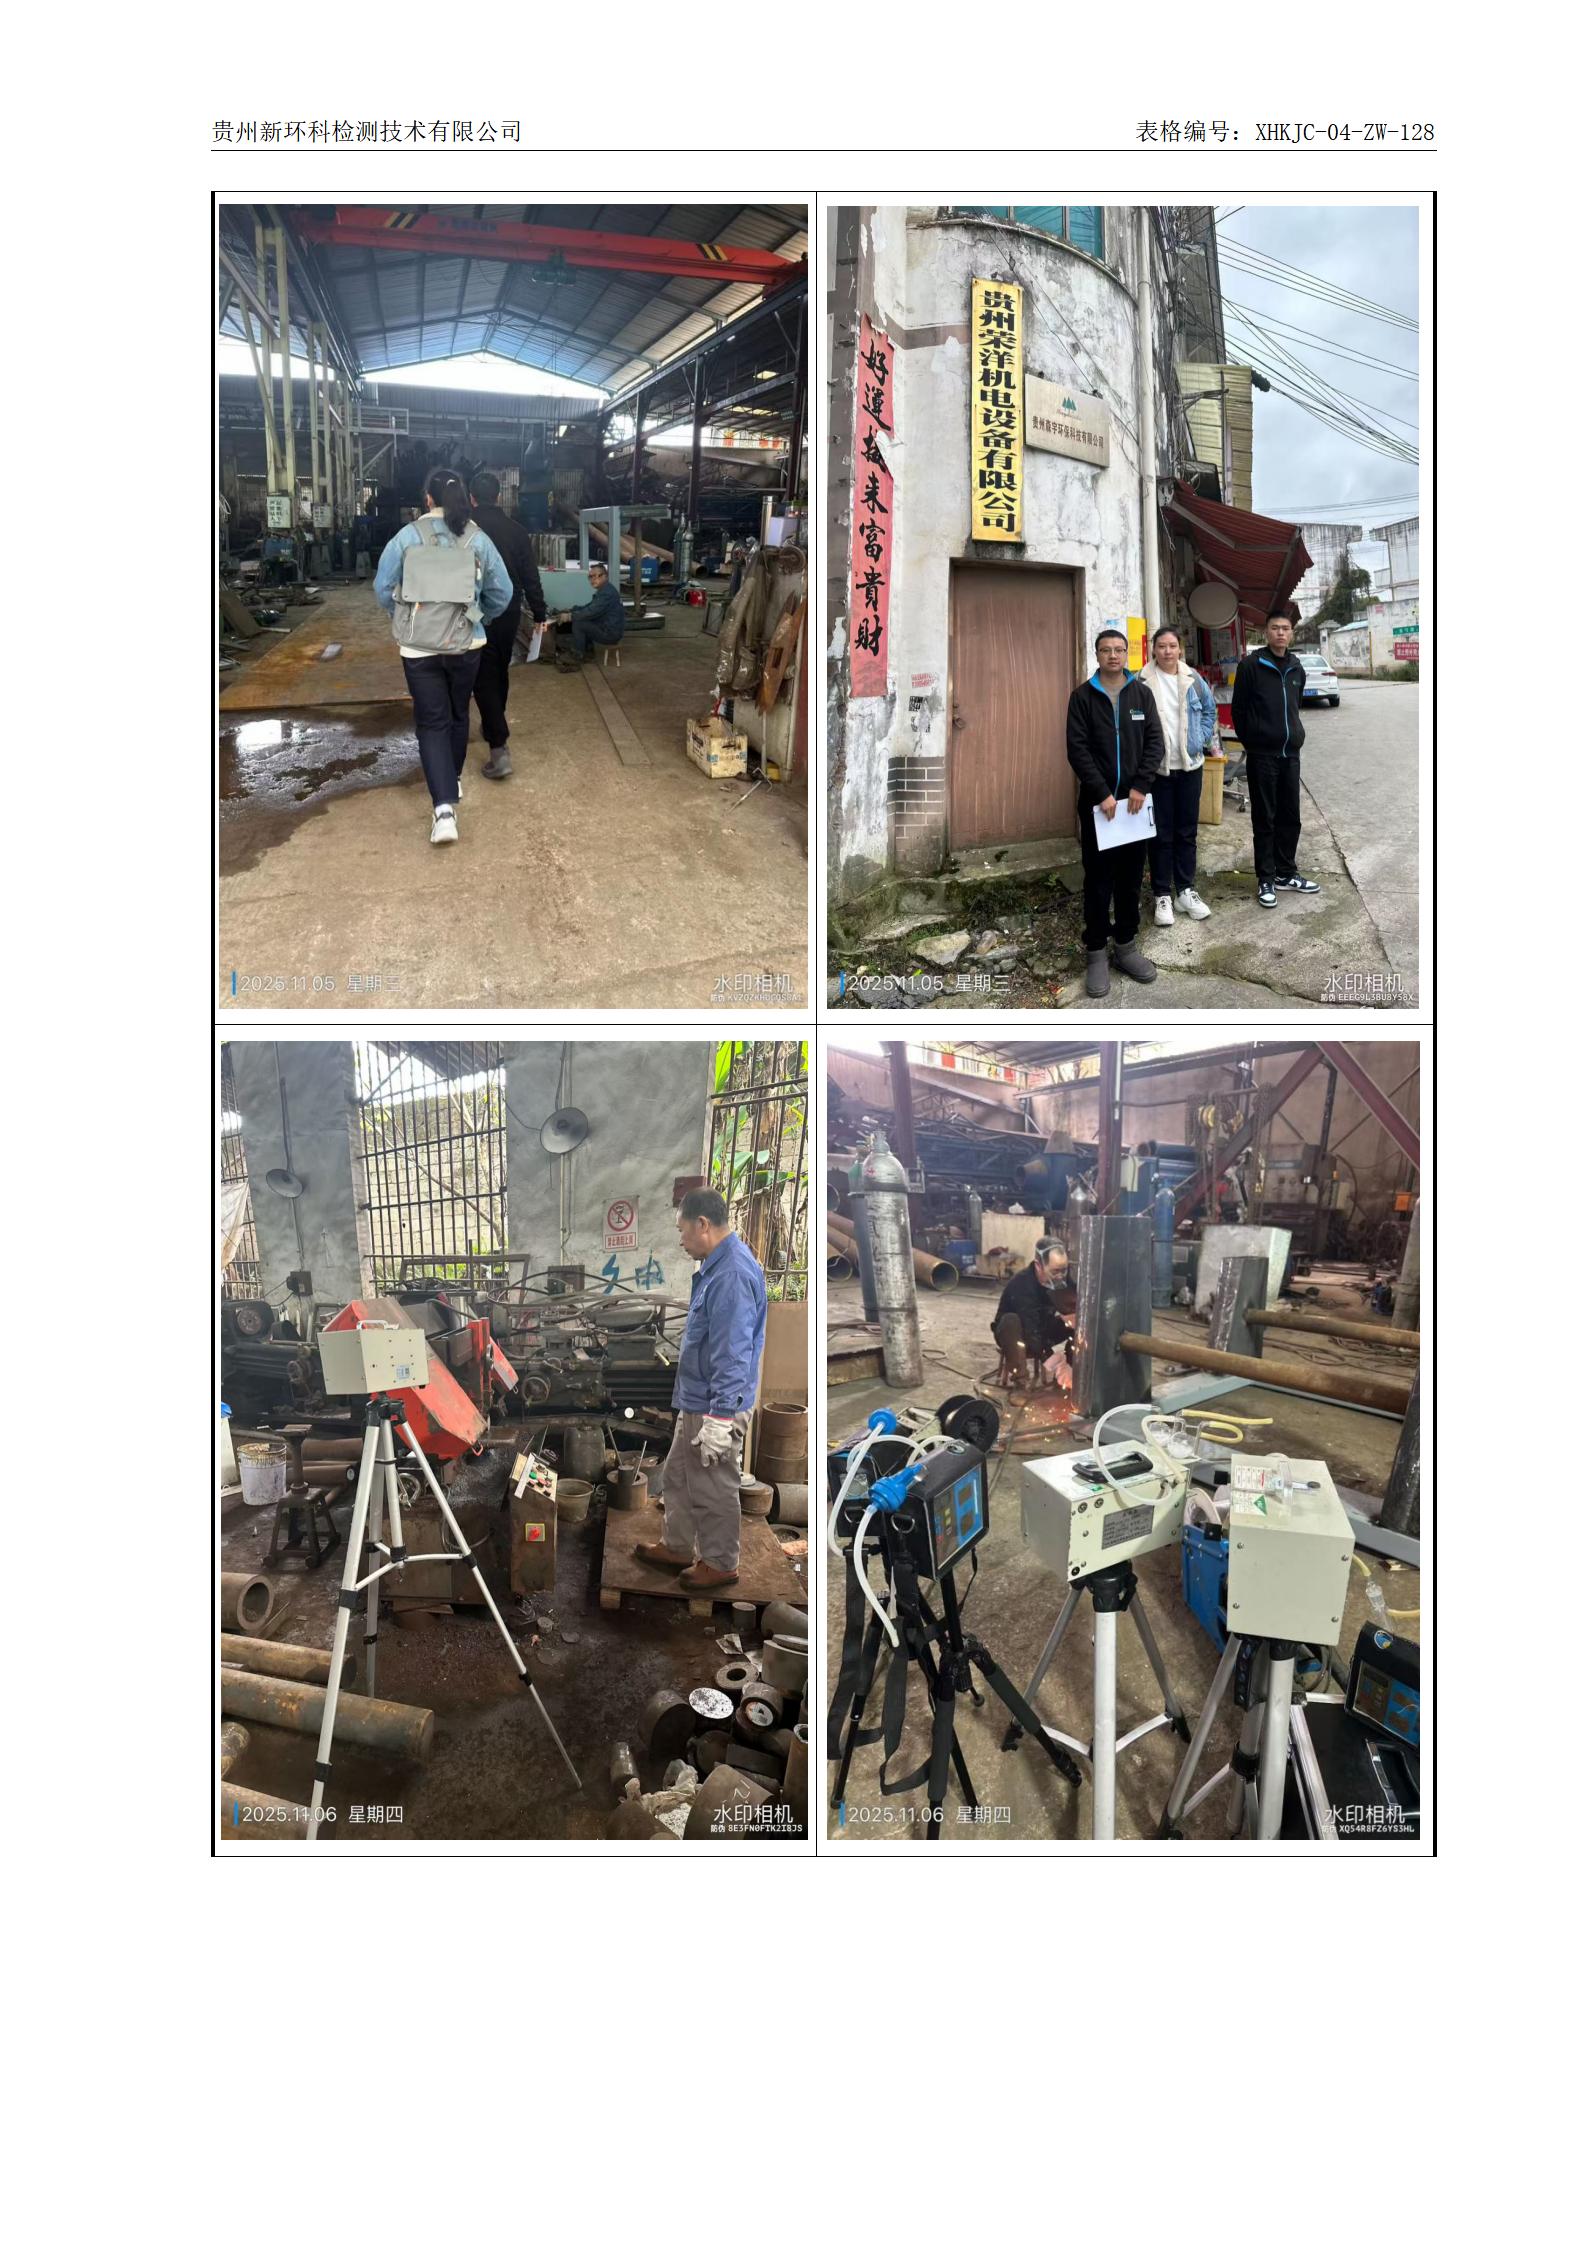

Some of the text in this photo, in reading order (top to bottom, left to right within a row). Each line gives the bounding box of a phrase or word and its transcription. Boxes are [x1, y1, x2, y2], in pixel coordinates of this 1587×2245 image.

[212, 119, 521, 143] 贵州新环科检测技术有限公司
[978, 290, 1017, 533] 贵州荣洋机电设备有限公司
